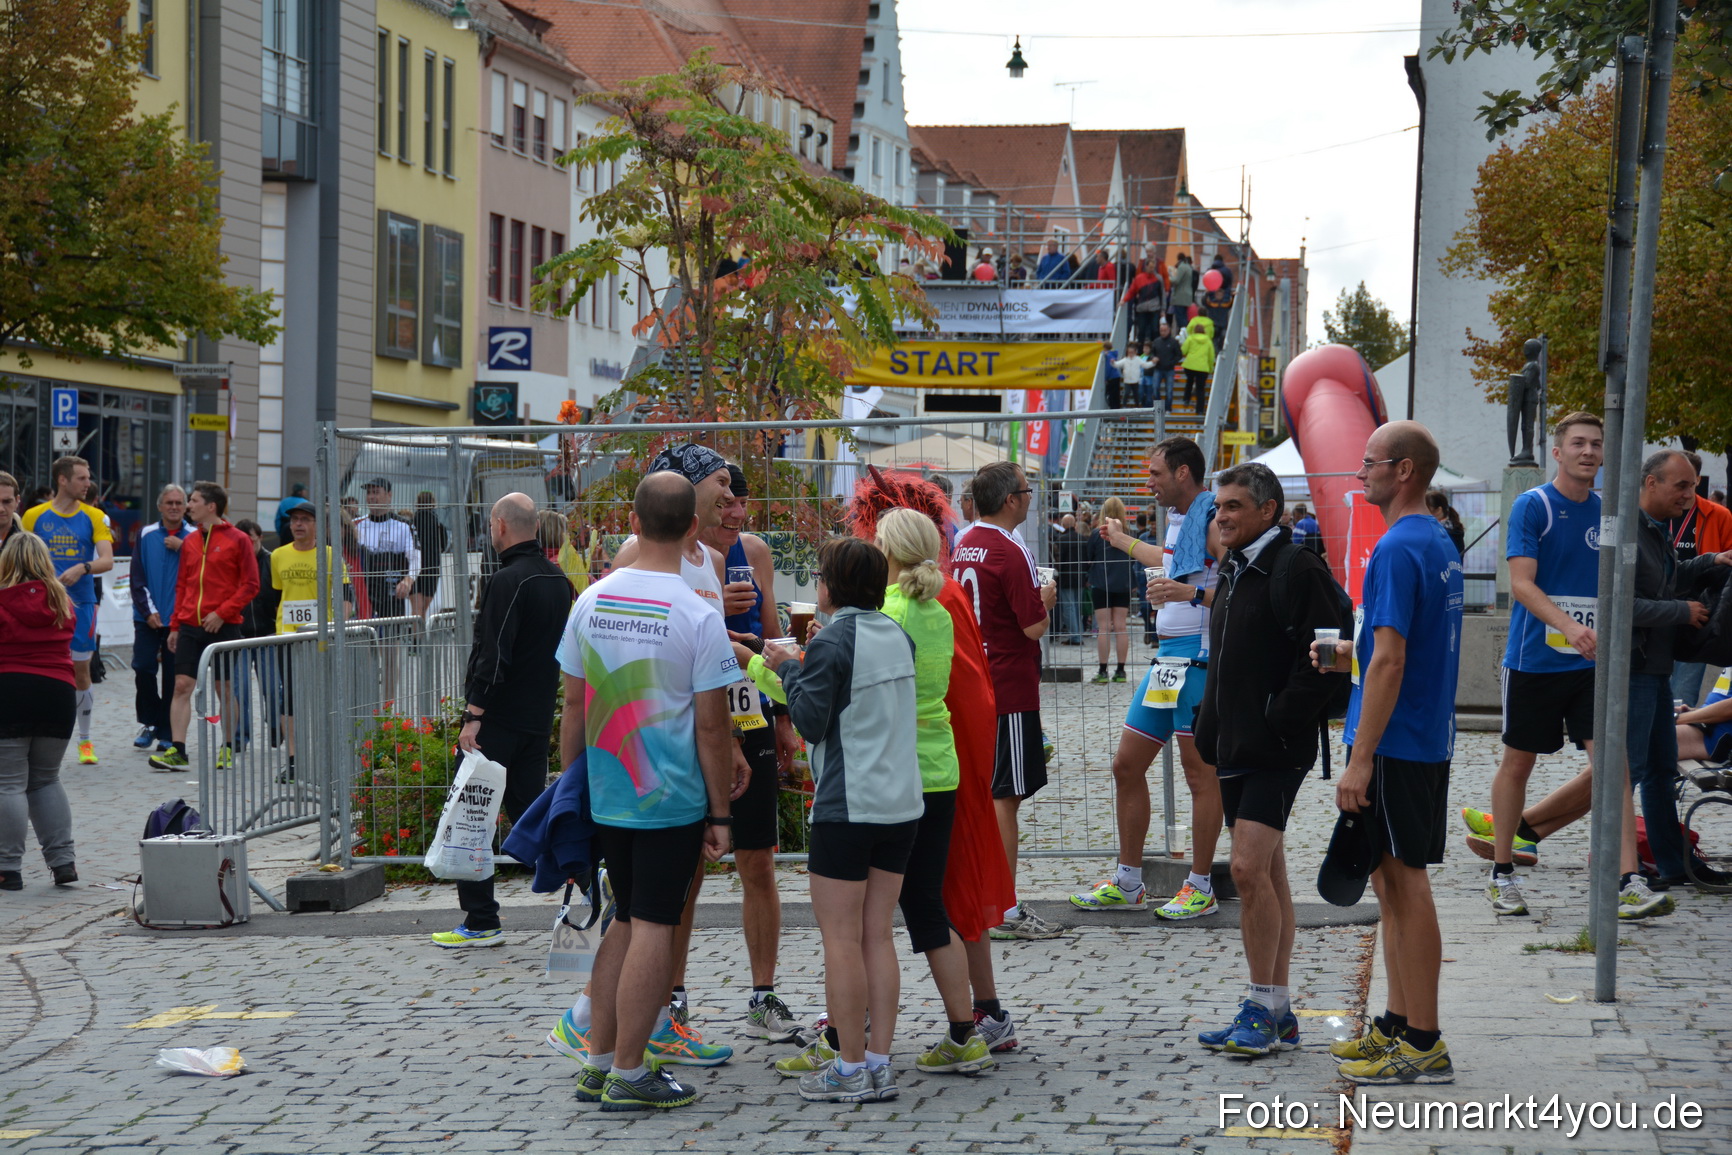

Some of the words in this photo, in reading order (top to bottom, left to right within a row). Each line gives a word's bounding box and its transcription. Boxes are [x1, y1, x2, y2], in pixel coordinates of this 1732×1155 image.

[890, 350, 1000, 377] START
[58, 393, 73, 422] P
[289, 608, 312, 622] 186
[588, 615, 670, 638] NeuerMarkt
[1156, 668, 1178, 688] 145
